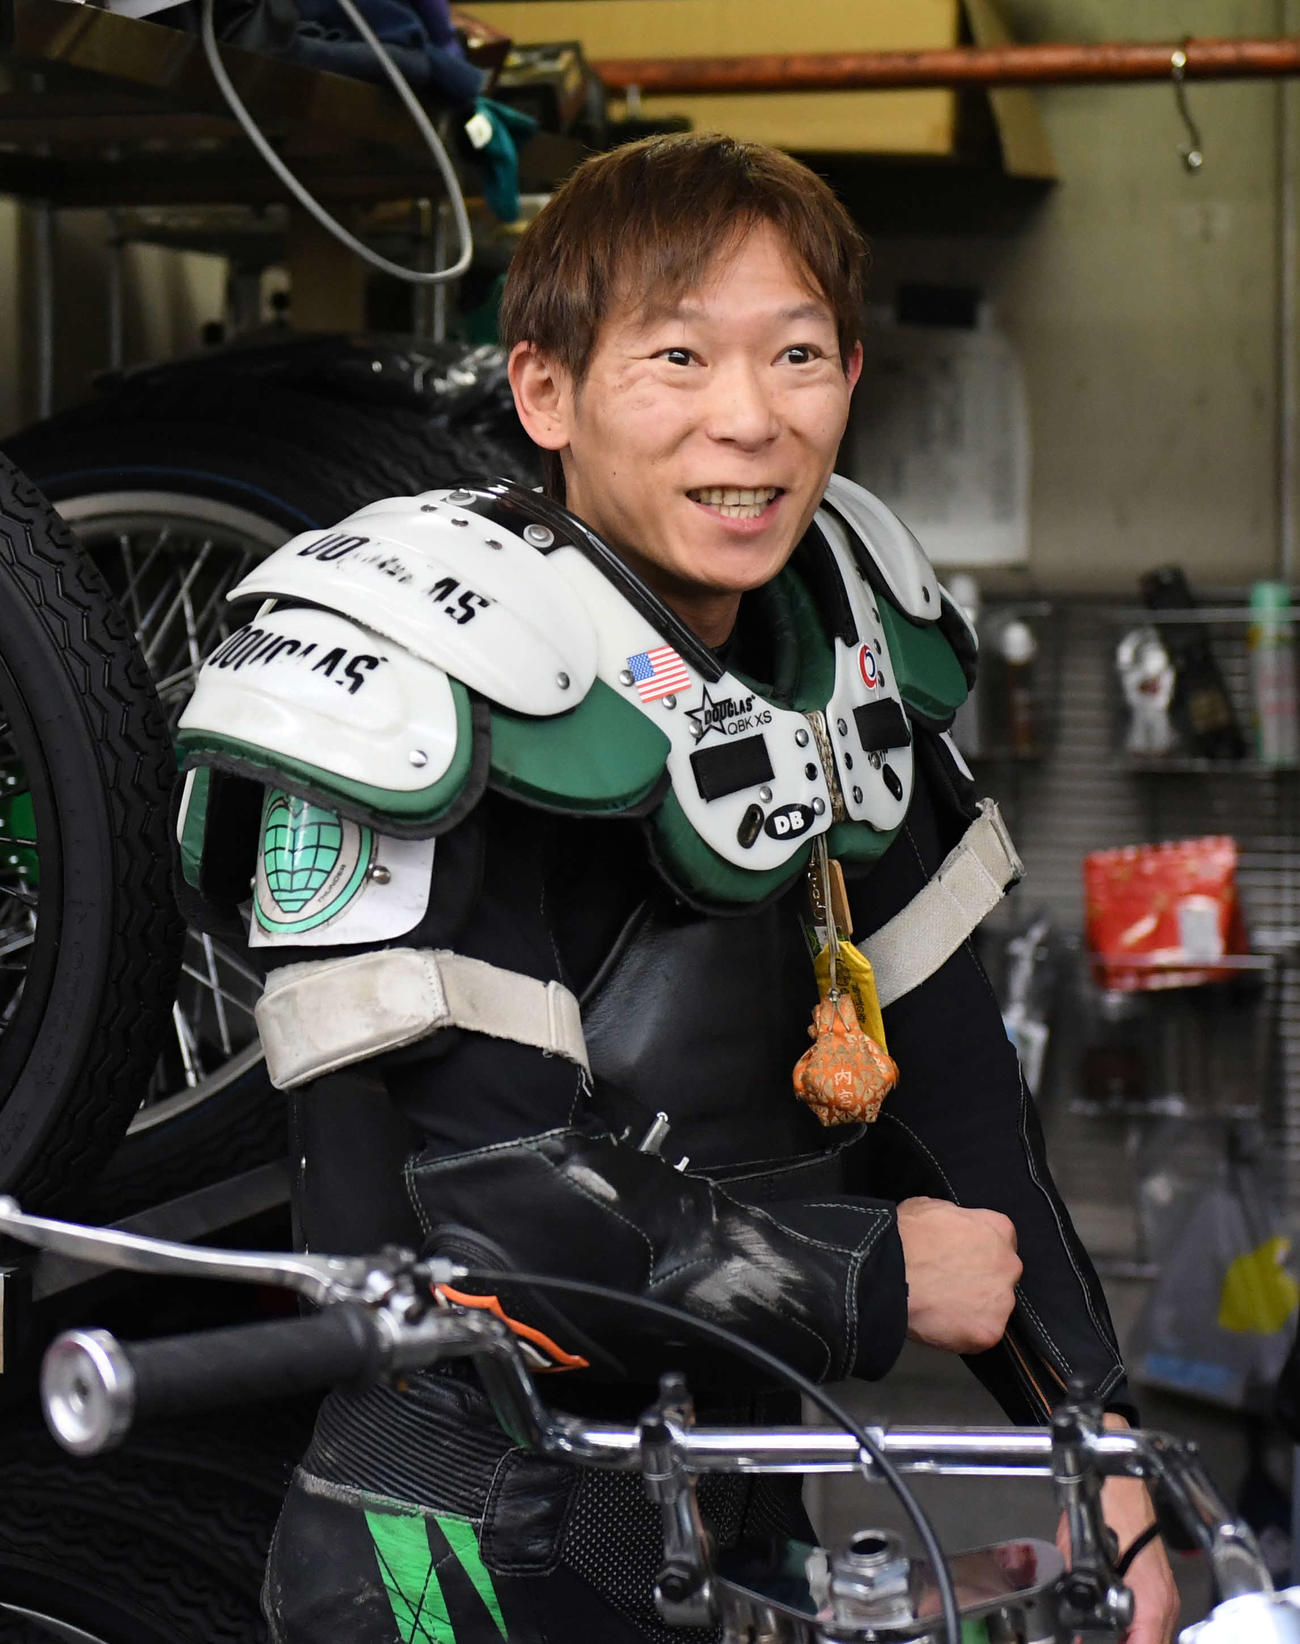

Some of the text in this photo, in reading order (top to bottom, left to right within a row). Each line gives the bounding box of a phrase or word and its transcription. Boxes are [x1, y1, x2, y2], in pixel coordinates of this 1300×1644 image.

[297, 533, 490, 625] DOAS
[704, 696, 753, 726] DOUGLAS
[727, 710, 772, 735] QBK XS
[774, 810, 805, 835] DB
